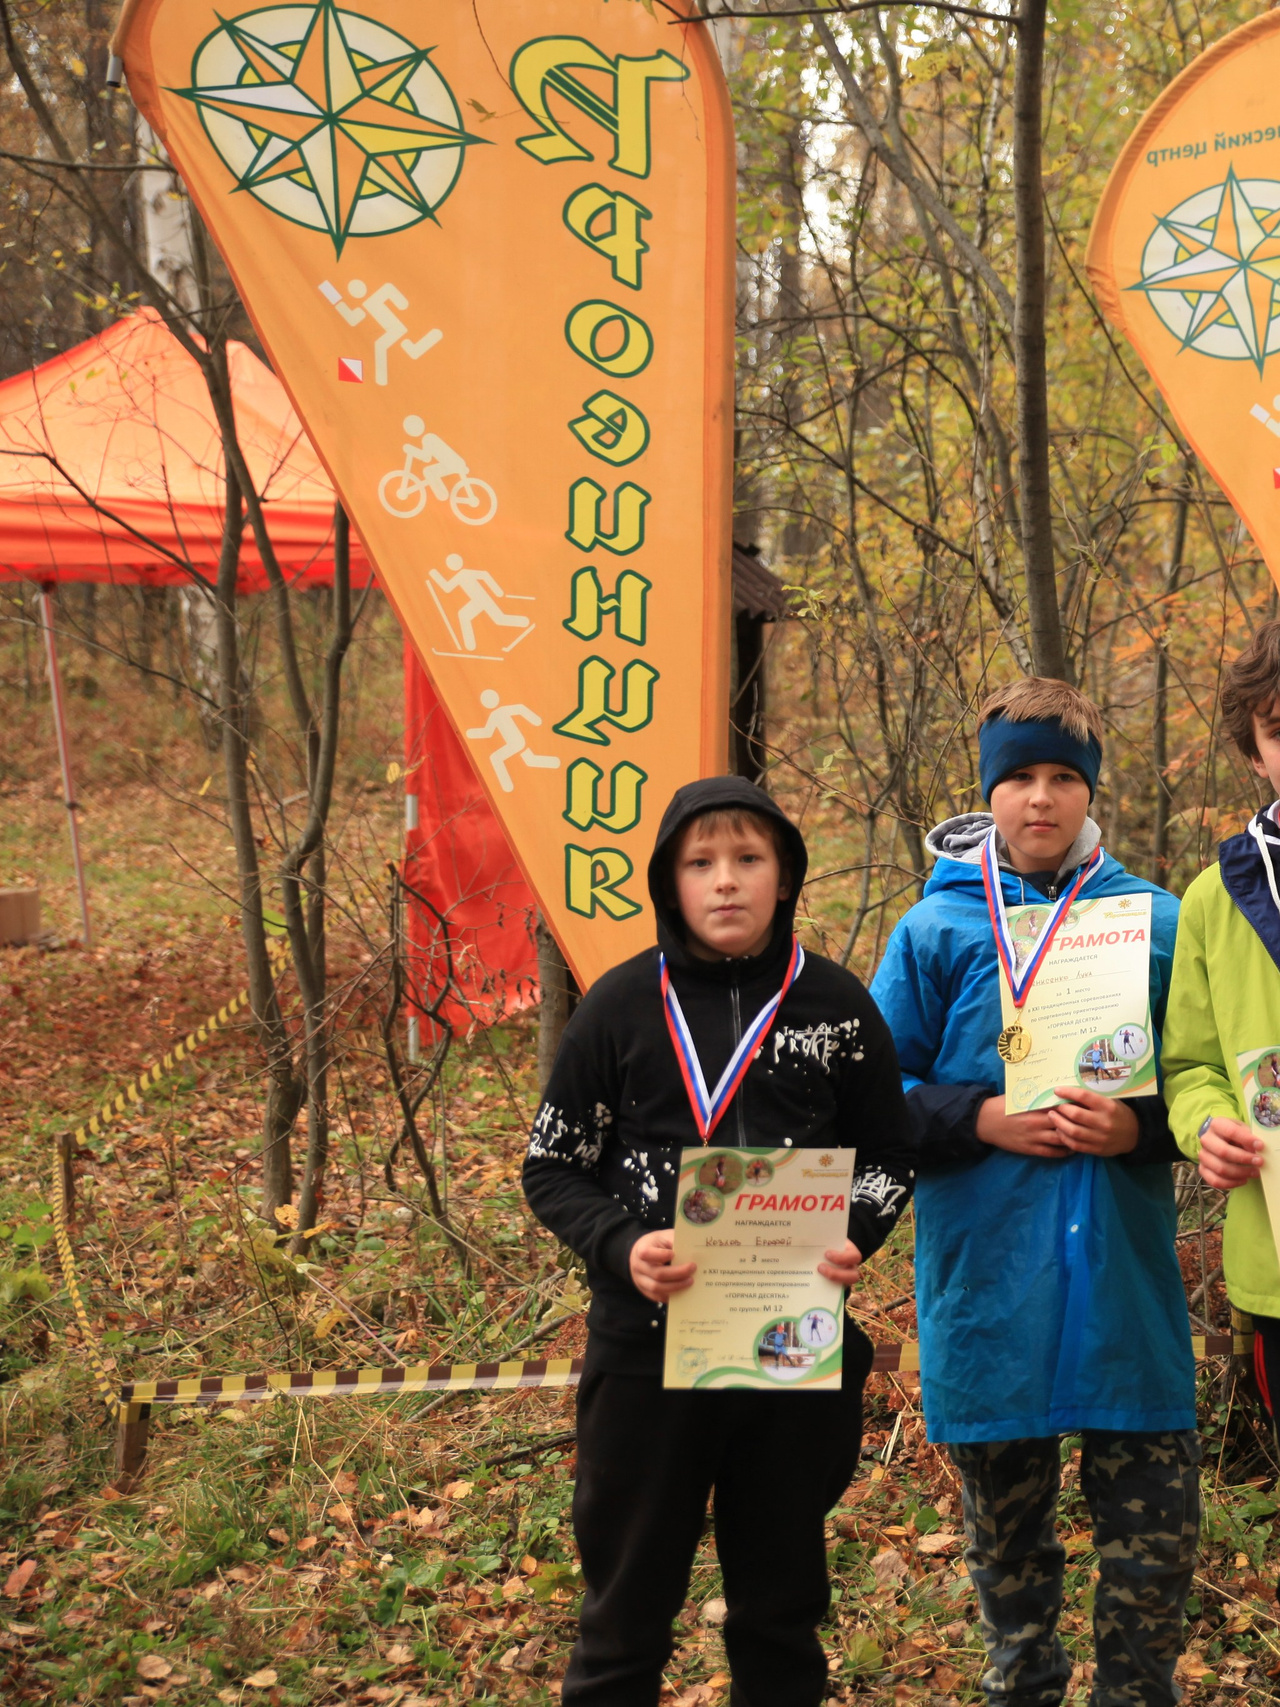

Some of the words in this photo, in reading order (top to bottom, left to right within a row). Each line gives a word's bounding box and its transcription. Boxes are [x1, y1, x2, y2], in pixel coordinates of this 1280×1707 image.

[1047, 928, 1146, 952] ГРАМОТА
[1049, 954, 1098, 966] НАГРАЖДАЕТСЯ
[1066, 987, 1071, 995] 1
[1075, 986, 1091, 994] место
[1041, 999, 1080, 1011] традиционных
[1080, 992, 1121, 1003] соревнованиях
[1037, 1010, 1072, 1022] спортивному
[1072, 1003, 1120, 1015] ориентированию
[1089, 1026, 1097, 1034] 12
[1016, 1037, 1022, 1051] 1
[735, 1194, 845, 1212] ГРАМОТА
[735, 1220, 791, 1228] НАГРАЖДАЕТСЯ
[751, 1254, 757, 1263] 3
